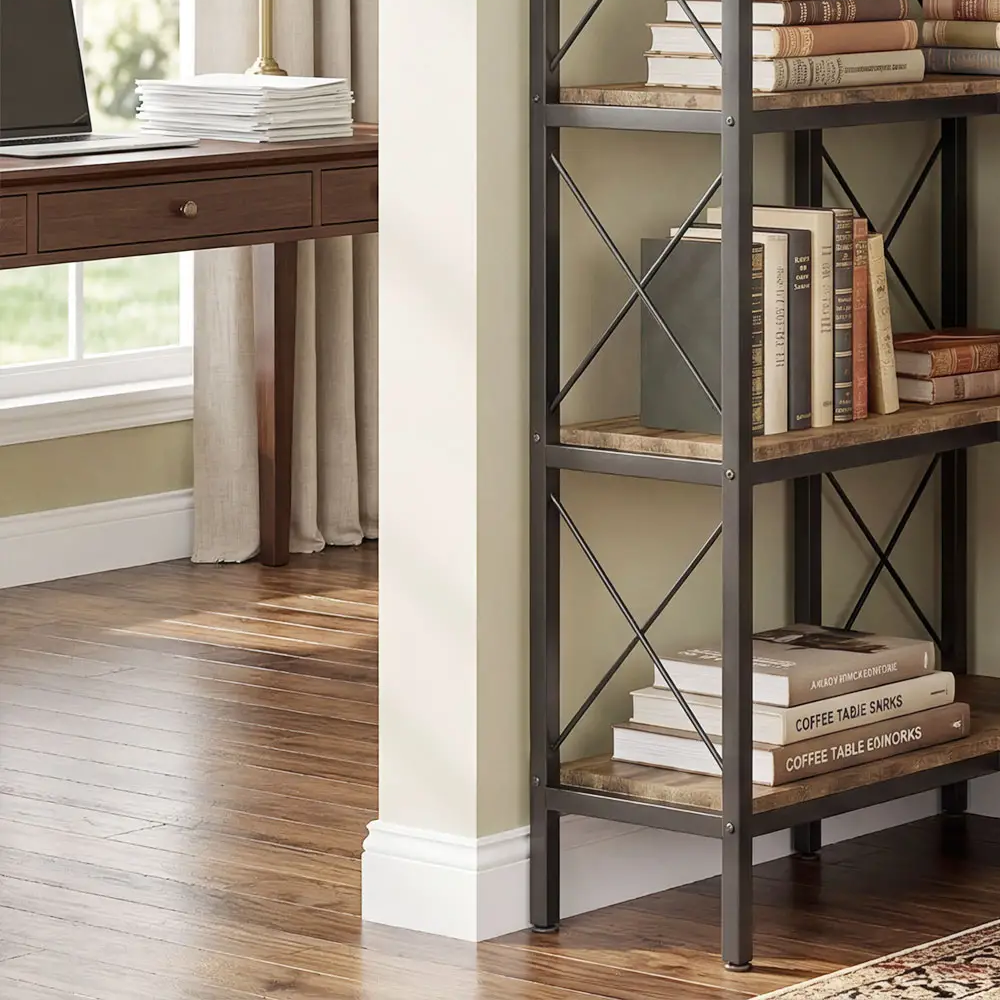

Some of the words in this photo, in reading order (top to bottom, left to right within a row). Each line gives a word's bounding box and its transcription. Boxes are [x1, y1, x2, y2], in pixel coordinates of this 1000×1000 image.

[795, 711, 834, 732] COFFEE
[786, 748, 828, 772] COFFEE
[830, 740, 865, 761] TABLE
